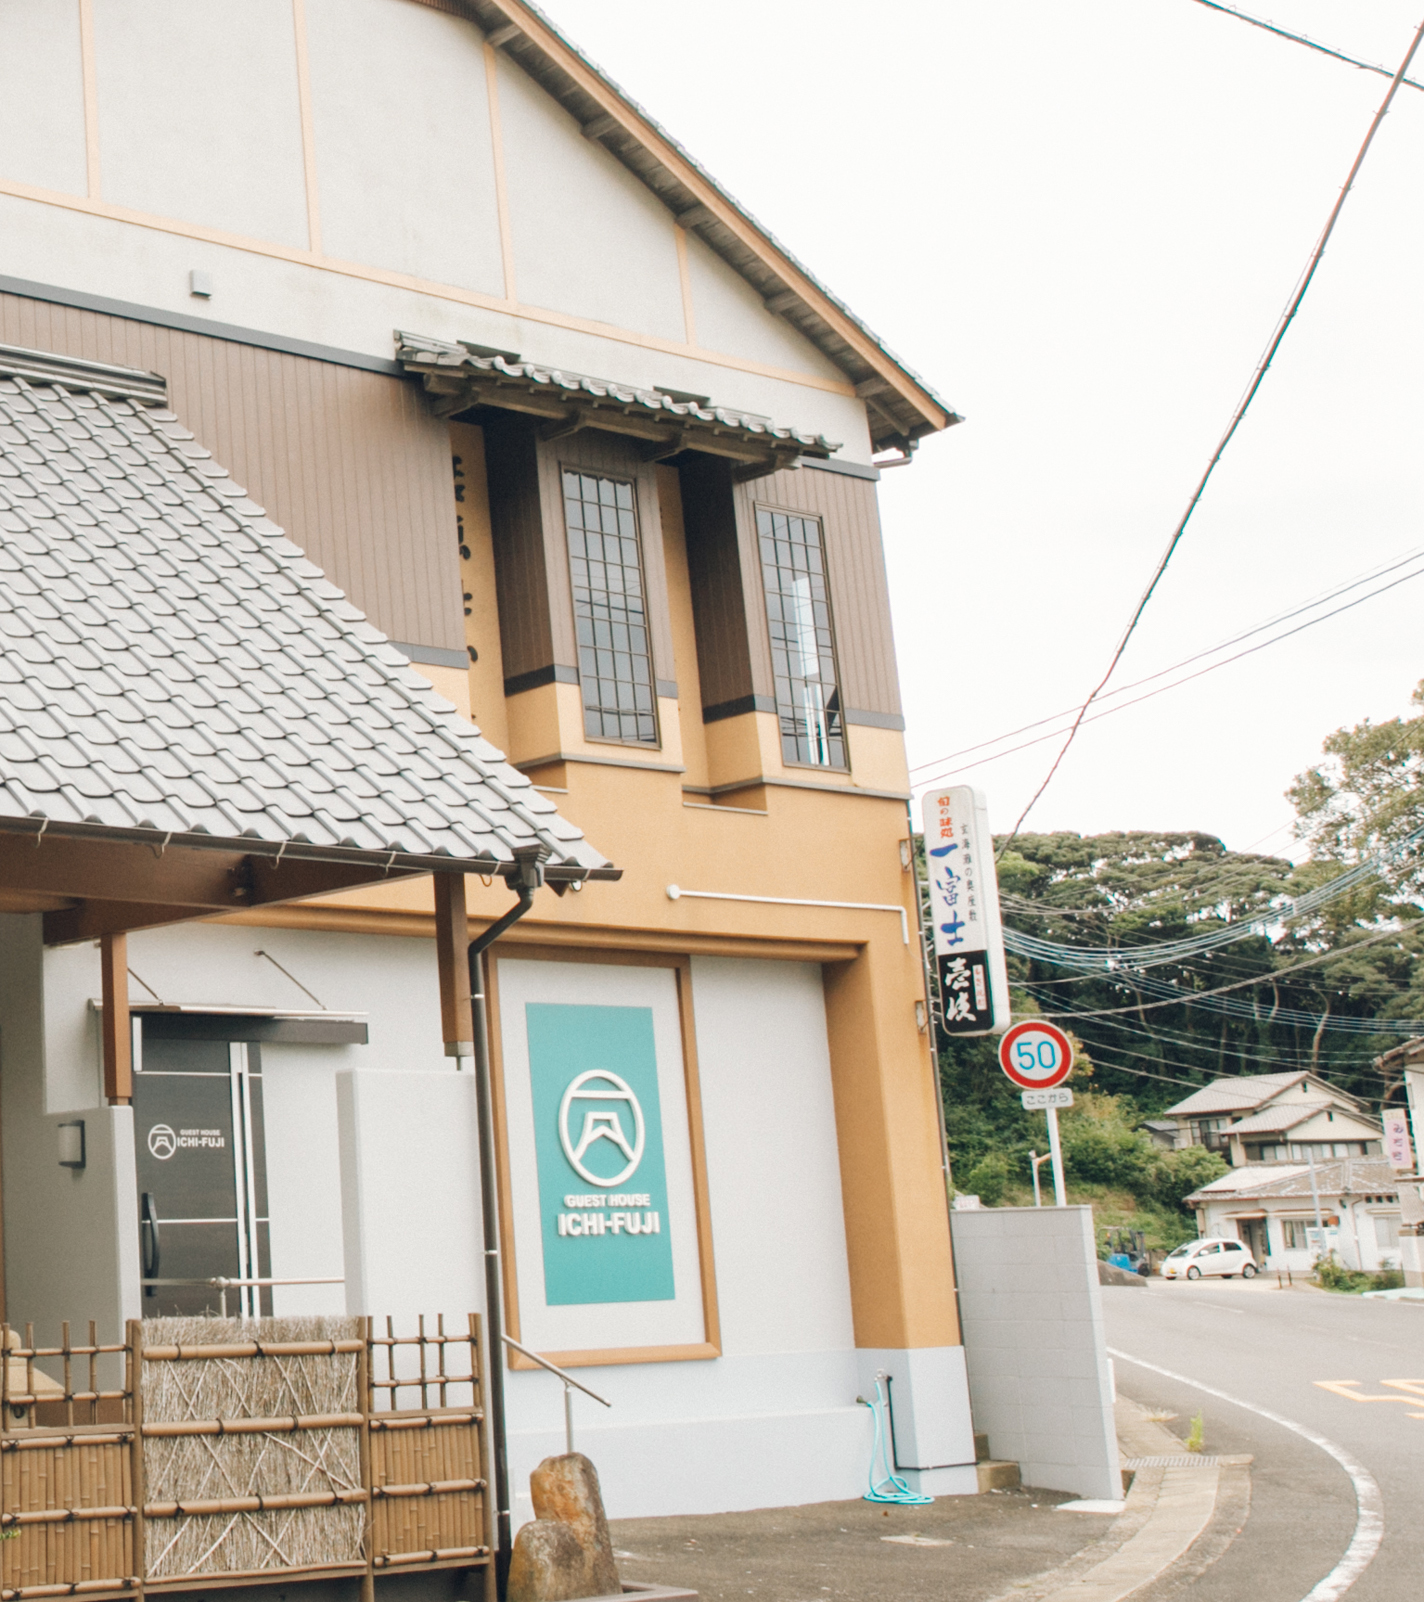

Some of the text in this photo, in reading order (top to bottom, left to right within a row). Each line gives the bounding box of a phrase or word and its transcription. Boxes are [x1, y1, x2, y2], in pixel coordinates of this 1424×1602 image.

[937, 796, 954, 839] 旬の味処
[929, 843, 965, 946] 一富士
[944, 956, 977, 1022] 壱岐
[1016, 1041, 1056, 1070] 50
[1026, 1092, 1069, 1105] ここから
[176, 1137, 225, 1148] ICHI-FUJI
[563, 1193, 651, 1208] GUEST HOUSE
[557, 1211, 661, 1236] ICHI-FUJI
